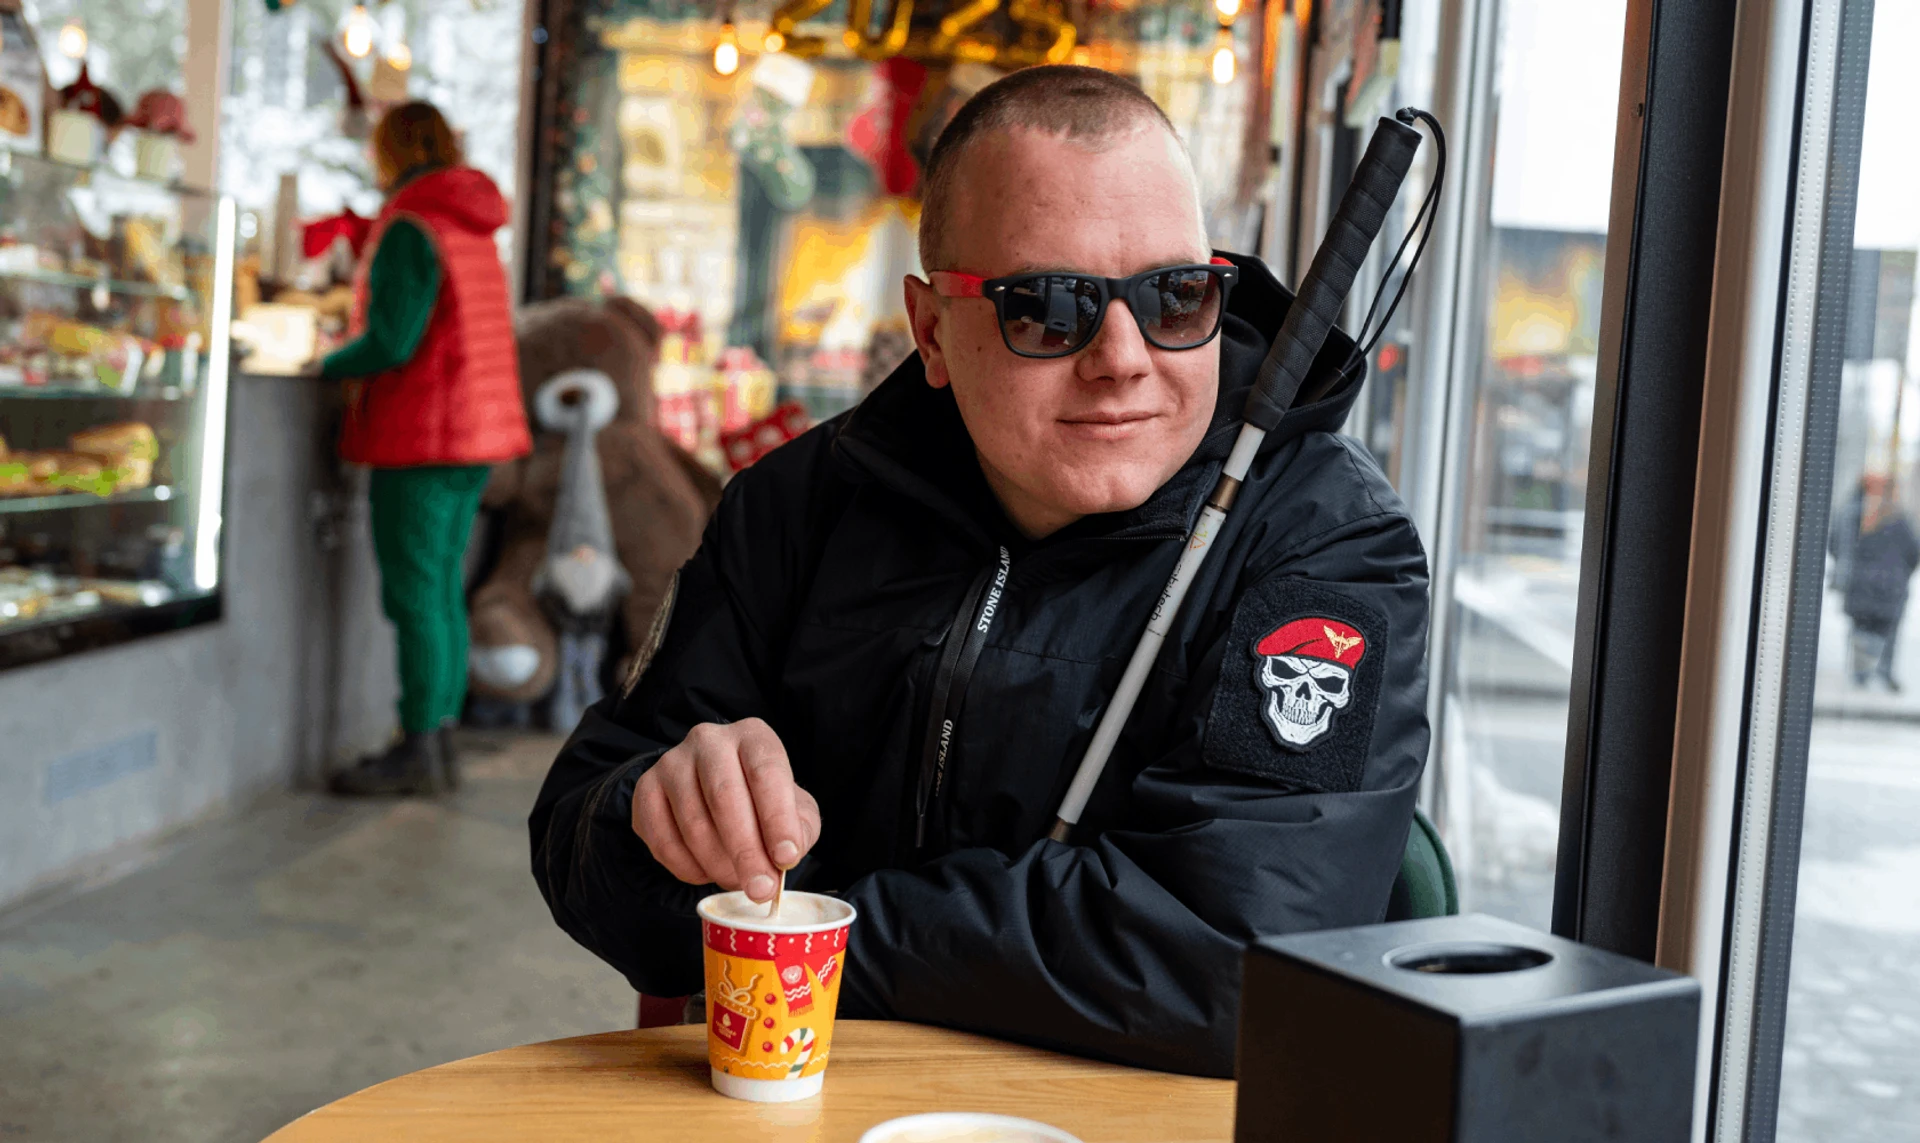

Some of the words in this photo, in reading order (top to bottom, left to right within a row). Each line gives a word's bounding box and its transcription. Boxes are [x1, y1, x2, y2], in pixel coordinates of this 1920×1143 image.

[977, 587, 1002, 633] STONE
[995, 545, 1011, 588] ISLAND
[938, 719, 954, 770] ISLAND
